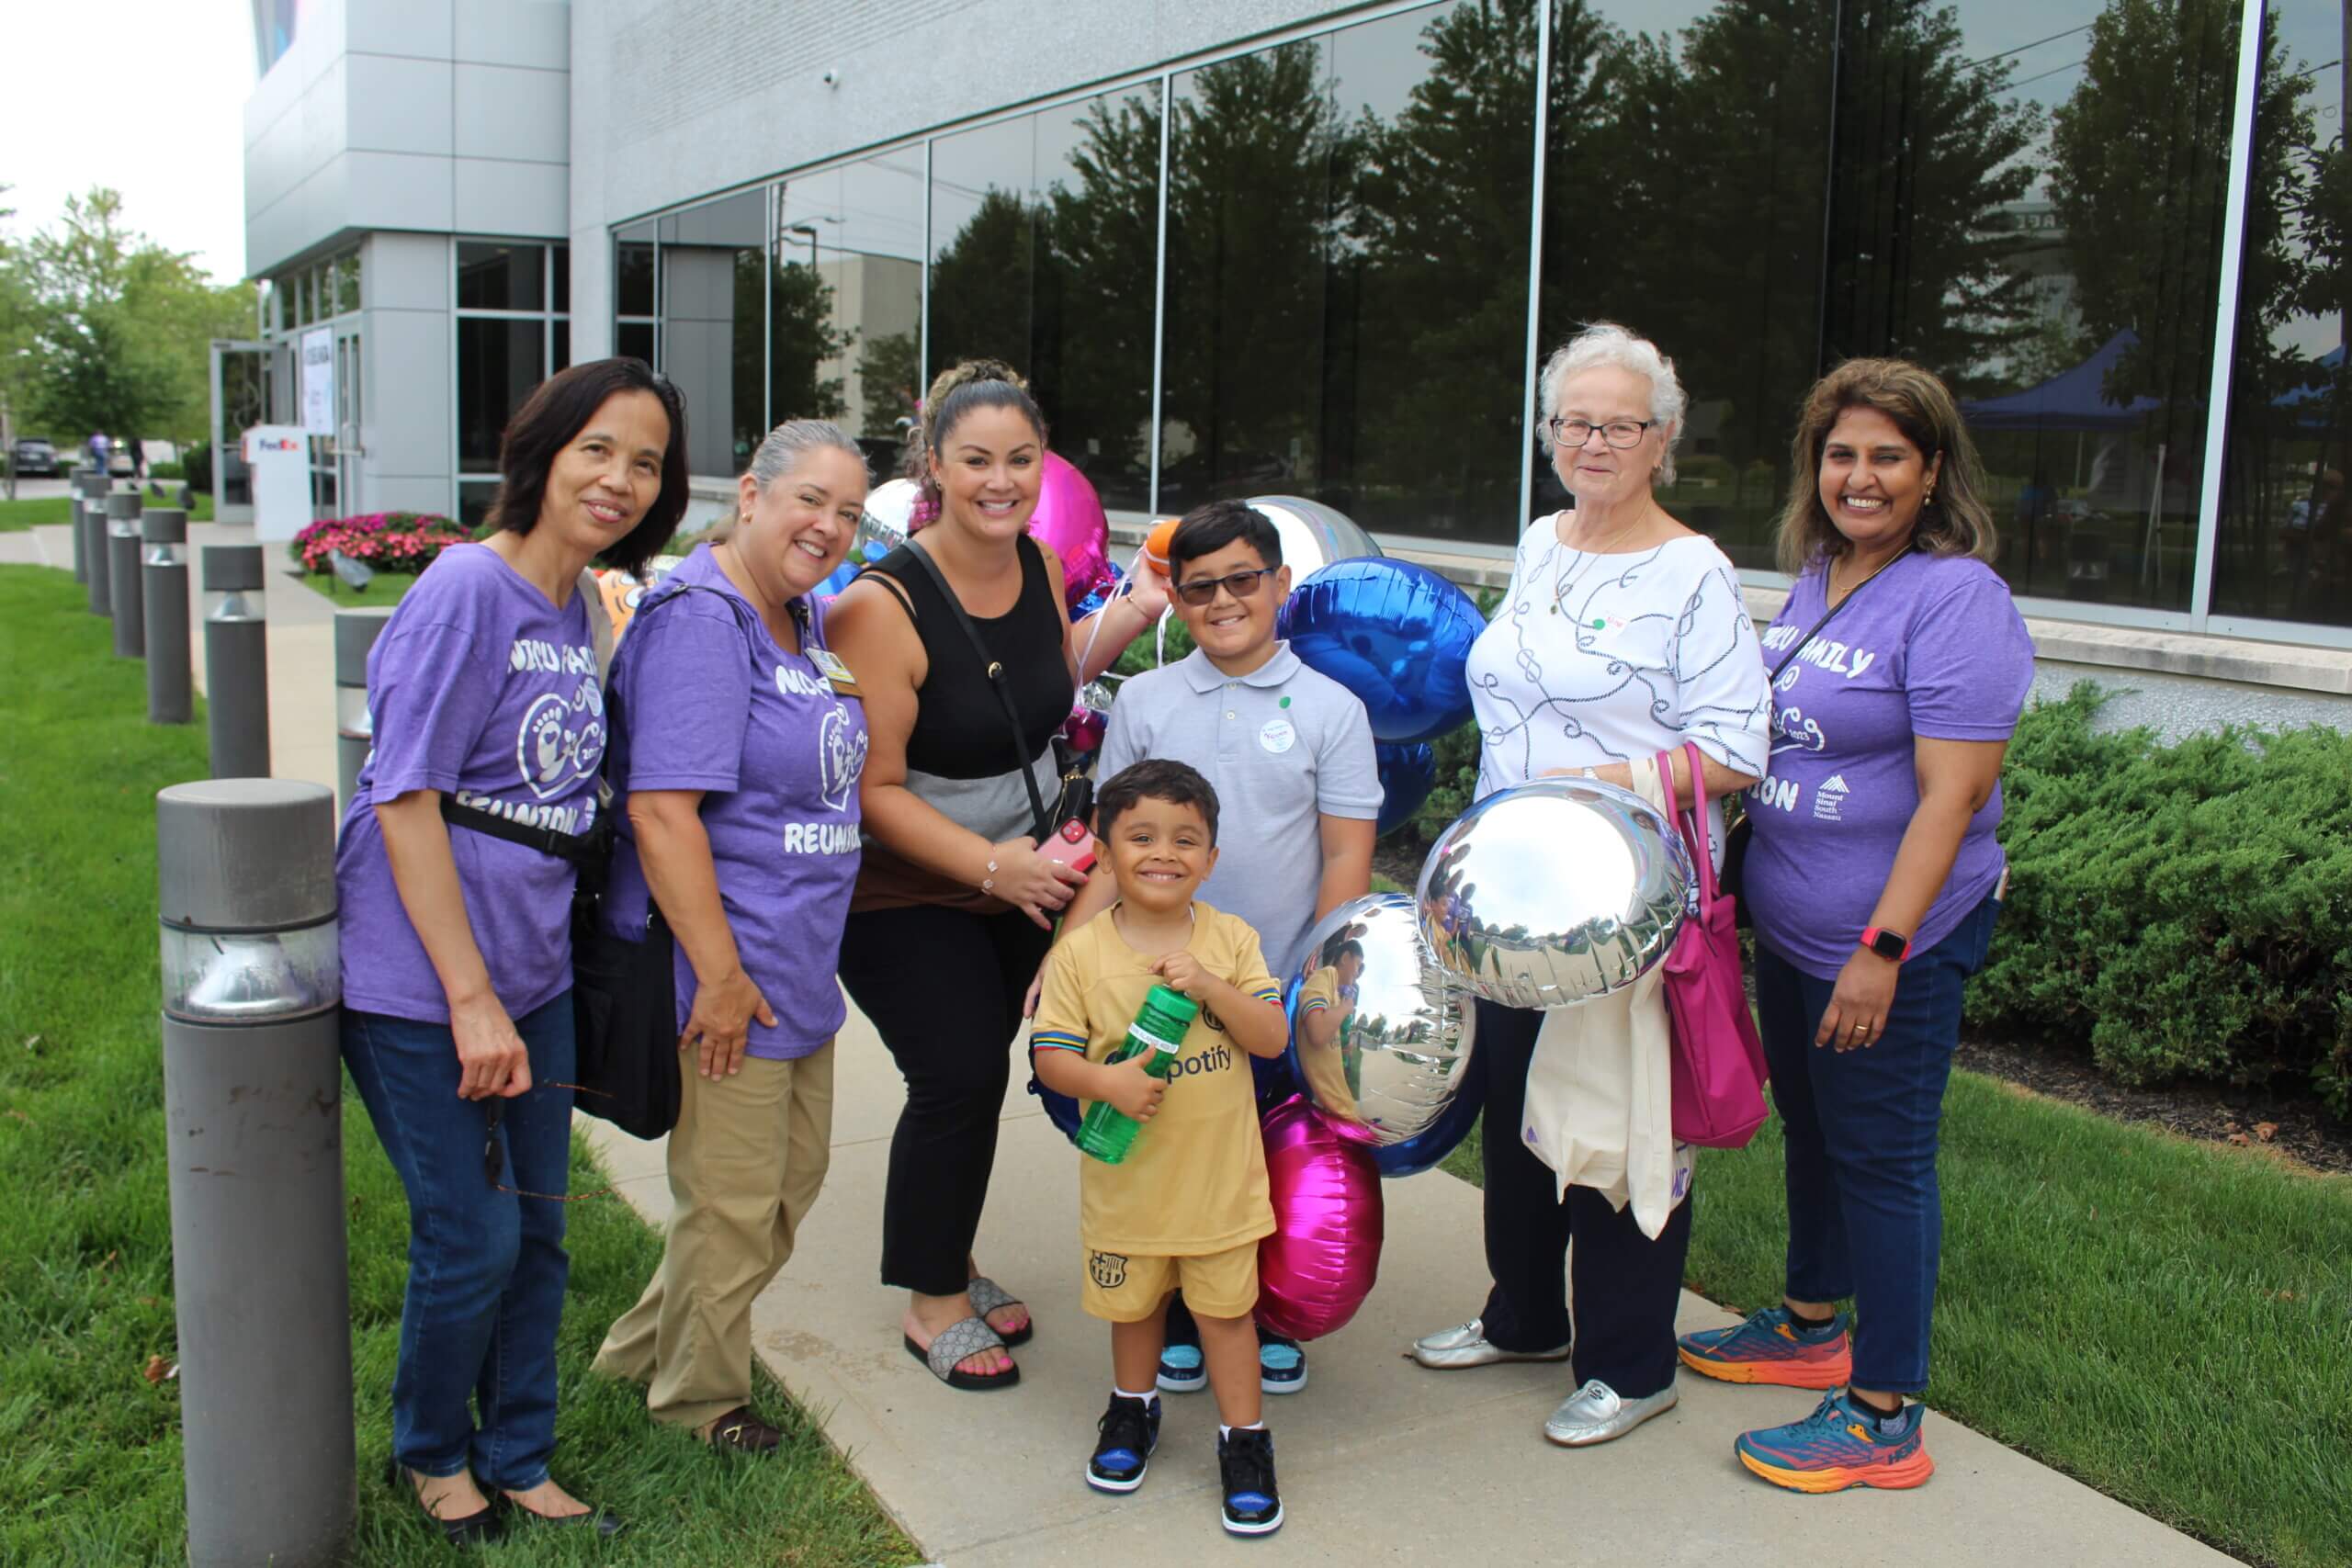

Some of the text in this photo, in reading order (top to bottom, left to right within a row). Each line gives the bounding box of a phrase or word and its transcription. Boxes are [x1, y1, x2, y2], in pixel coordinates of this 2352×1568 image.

[1796, 632, 1875, 679] AMILY
[1816, 791, 1843, 801] Mount
[1815, 797, 1837, 807] Sinai
[1815, 805, 1838, 814] South
[1166, 1043, 1231, 1085] potify
